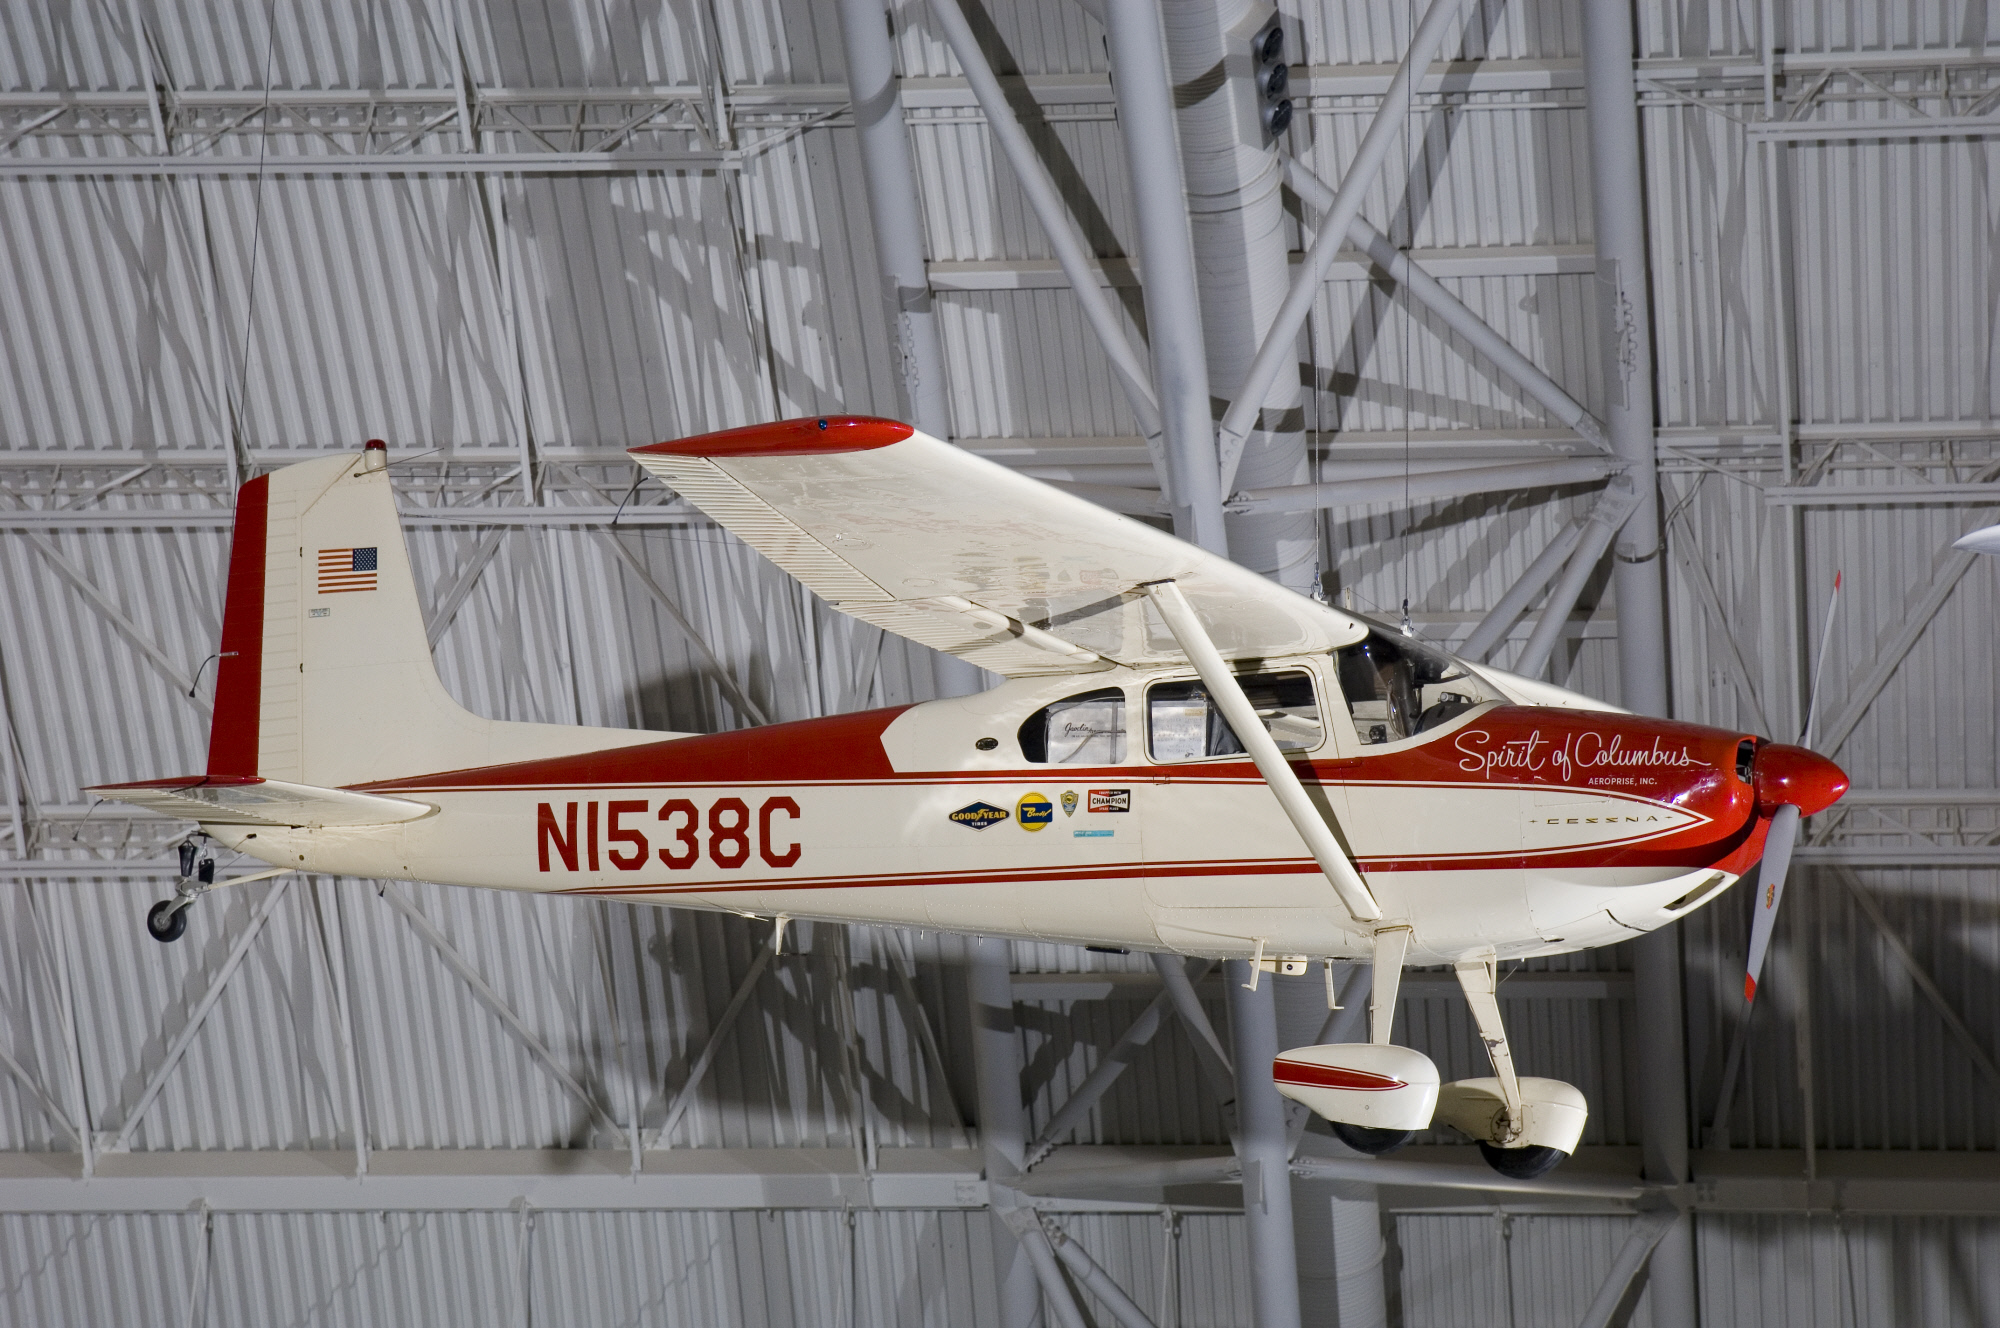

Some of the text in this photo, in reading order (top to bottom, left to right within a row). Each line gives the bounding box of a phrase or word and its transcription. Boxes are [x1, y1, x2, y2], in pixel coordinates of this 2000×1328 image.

[1454, 729, 1712, 782] Spirit of Columbus
[1588, 777, 1658, 787] AEROPRISE, INC.
[1092, 797, 1127, 805] CHAMPION
[1546, 815, 1659, 825] CESSNA
[537, 796, 802, 872] N1538C
